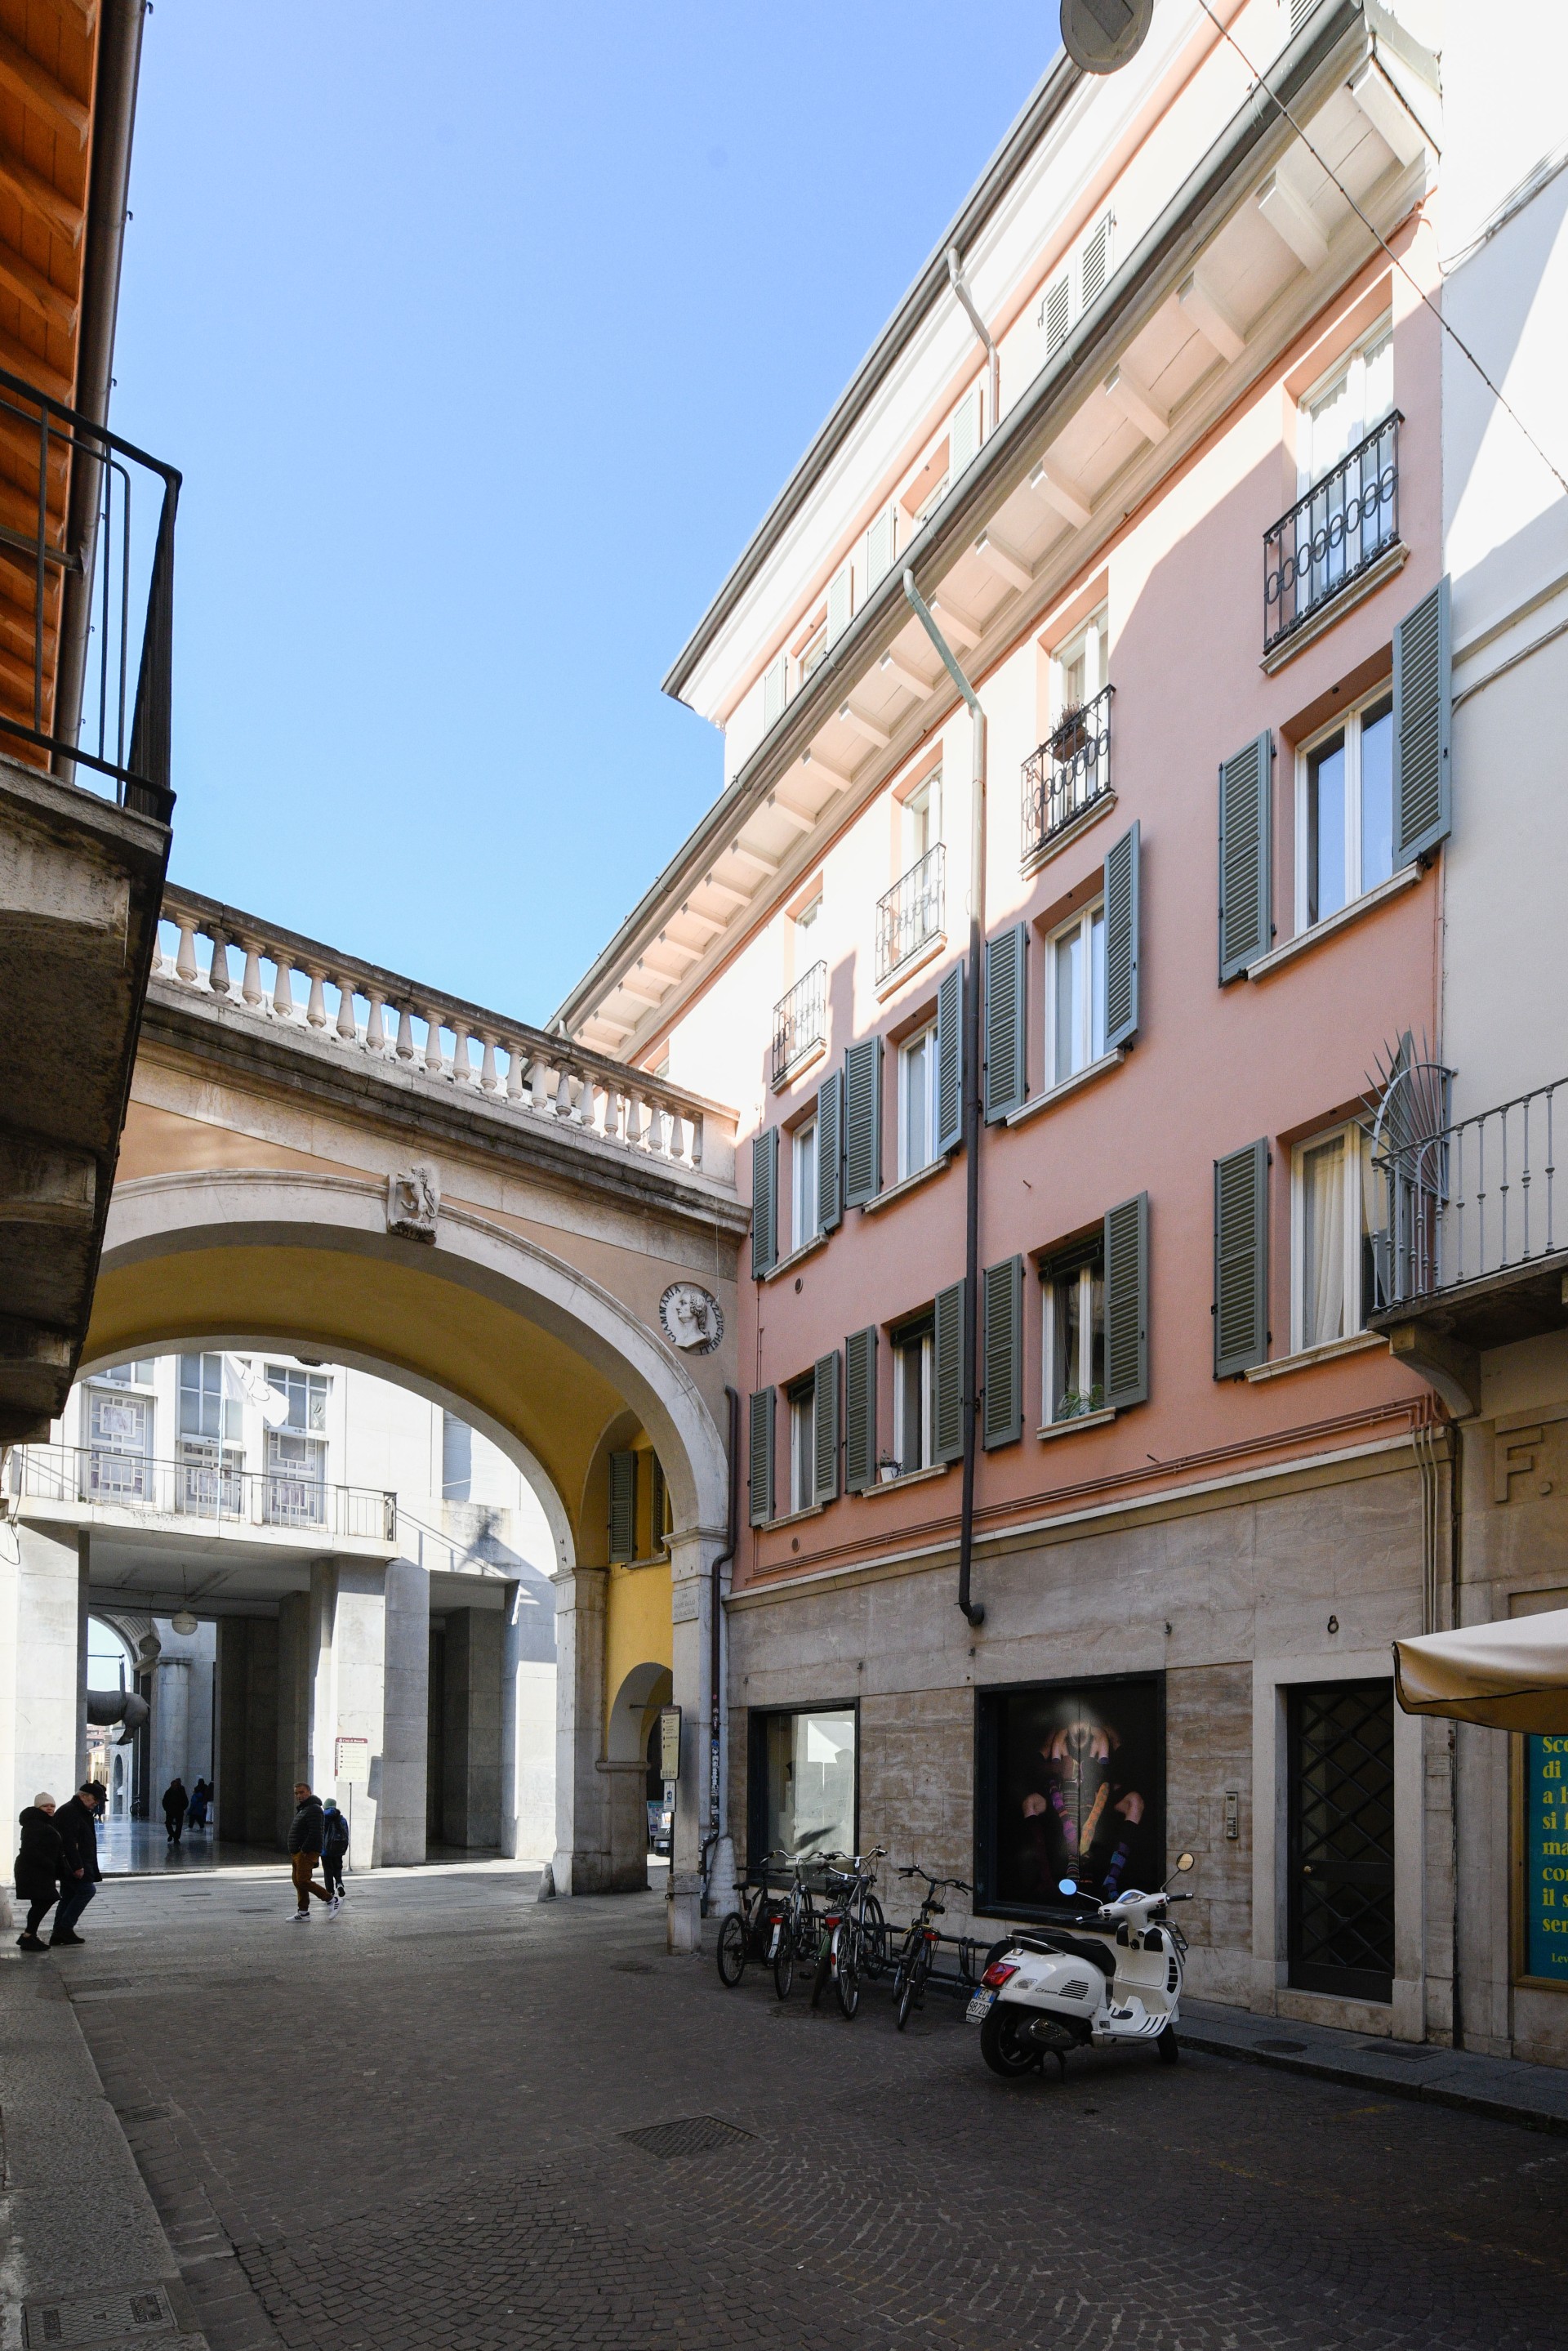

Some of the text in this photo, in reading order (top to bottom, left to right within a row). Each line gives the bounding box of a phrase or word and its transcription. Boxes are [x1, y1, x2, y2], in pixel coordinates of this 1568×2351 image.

[659, 1285, 724, 1355] GIAMMARIA MAZZUCHELLI
[1542, 1760, 1561, 1778] di
[1543, 1790, 1554, 1804] a
[1543, 1811, 1557, 1830] si
[1542, 1887, 1556, 1907] il
[978, 1987, 989, 2001] EC
[968, 2001, 990, 2016] 98720
